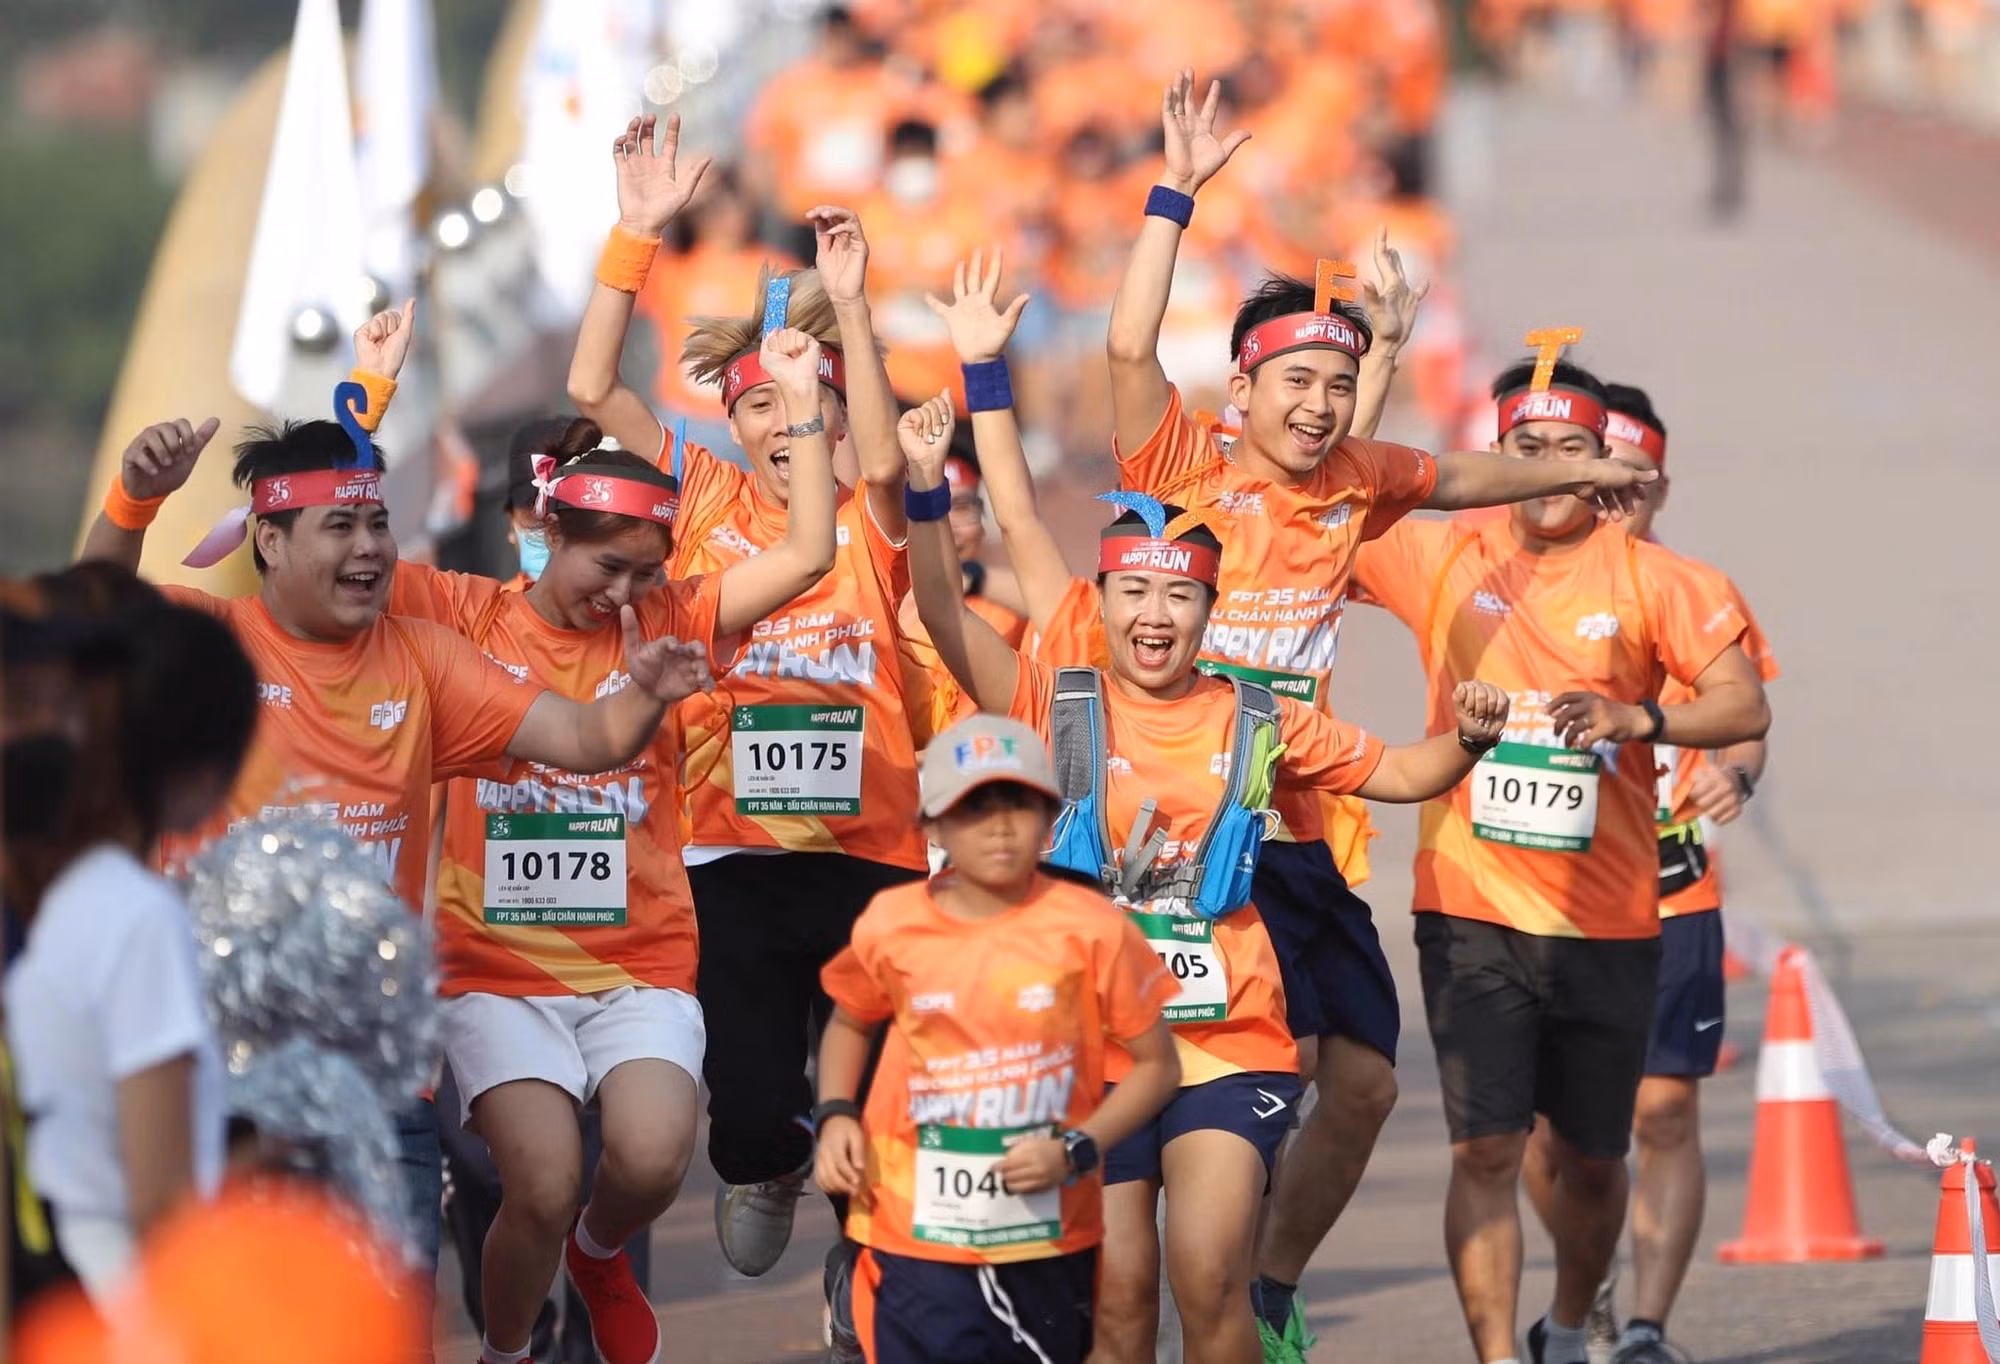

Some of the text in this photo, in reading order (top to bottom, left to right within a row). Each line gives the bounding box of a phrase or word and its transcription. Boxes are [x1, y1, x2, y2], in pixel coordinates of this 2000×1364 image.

[1315, 258, 1356, 315] F
[1295, 324, 1355, 350] HAPPY RUN
[1524, 327, 1584, 392] T
[1530, 399, 1572, 419] RUN
[334, 482, 382, 500] HAPPY RU
[1120, 550, 1192, 572] HAPPY RUN
[1228, 589, 1264, 604] FPT
[1264, 588, 1296, 606] 35
[795, 612, 835, 630] NĂM
[1227, 605, 1271, 622] CHÂN
[1274, 607, 1318, 625] HẠNH
[824, 616, 875, 643] PHÚC
[1266, 616, 1342, 673] RUN
[257, 681, 292, 704] OPE
[1287, 680, 1311, 695] RUN
[370, 700, 408, 731] FPT
[810, 713, 830, 723] HAPPY
[829, 709, 858, 724] RUN
[748, 742, 847, 771] 10175
[954, 735, 1017, 769] FPT
[476, 778, 551, 813] HAPPY
[1487, 775, 1584, 811] 10179
[343, 801, 385, 818] NĂM
[748, 801, 760, 811] FPT
[760, 801, 769, 811] 35
[800, 800, 818, 811] CHÂN
[370, 812, 409, 836] PHÚC
[568, 821, 592, 832] HAPPY
[590, 817, 619, 833] RUN
[502, 851, 611, 881] 10178
[496, 911, 509, 921] FPT
[510, 911, 520, 921] 35
[520, 910, 537, 921] NĂM
[542, 909, 556, 921] DẤU
[557, 910, 576, 921] CHÂN
[577, 911, 596, 923] HẠNH
[597, 910, 615, 921] PHÚC
[1184, 921, 1207, 936] RUN
[1179, 1007, 1197, 1021] HẠNH
[1197, 1006, 1216, 1017] PHÚC
[975, 1065, 1075, 1128] RUN
